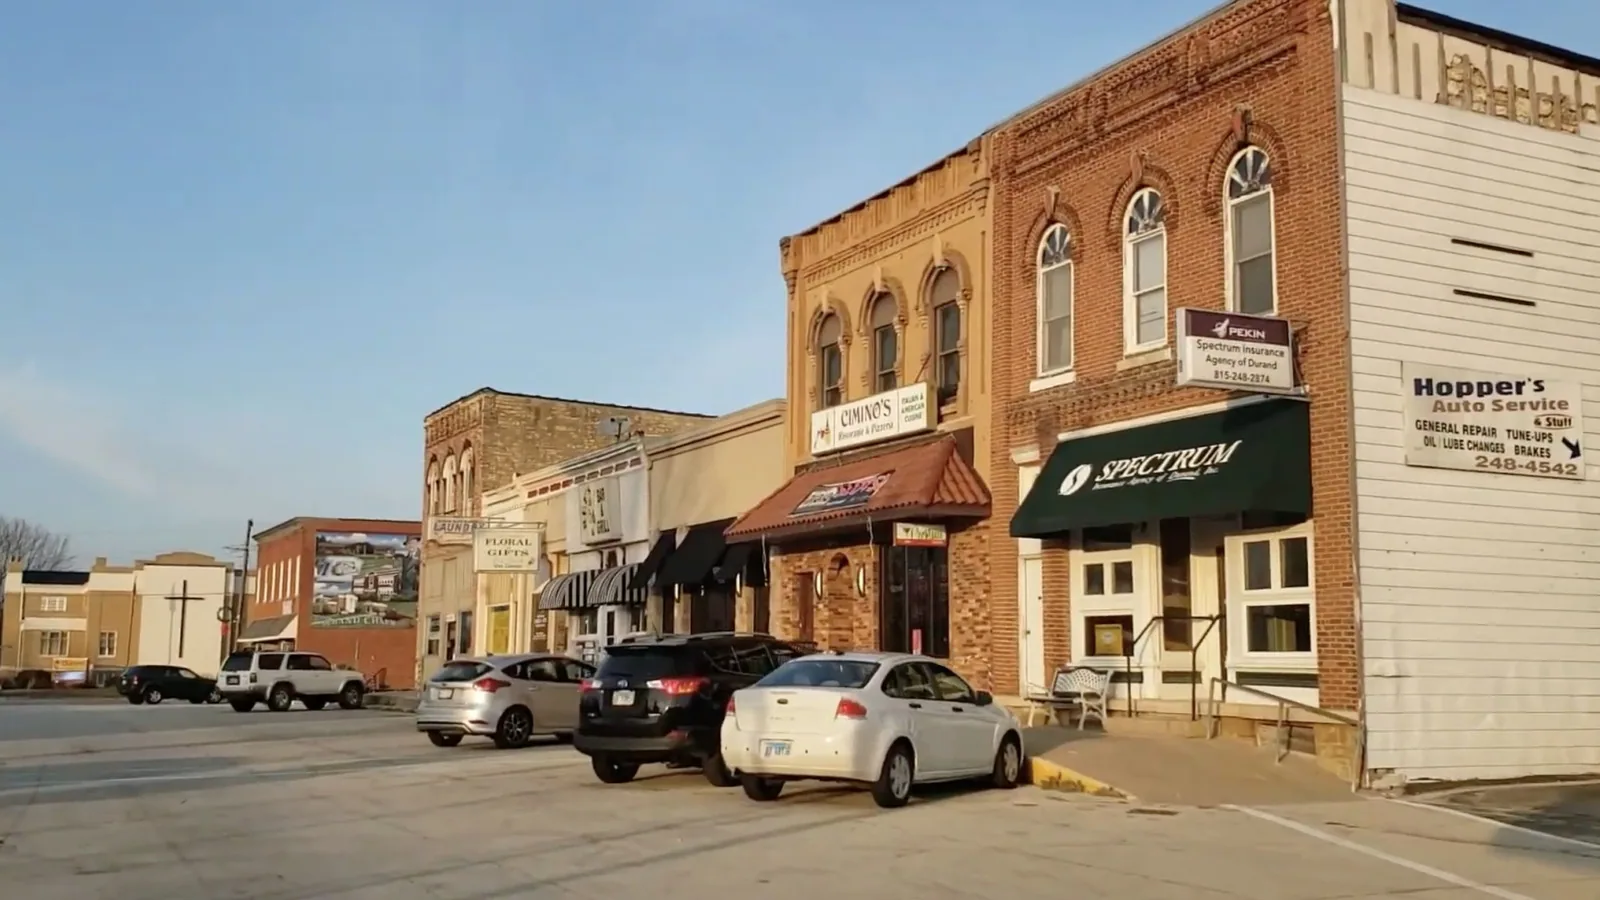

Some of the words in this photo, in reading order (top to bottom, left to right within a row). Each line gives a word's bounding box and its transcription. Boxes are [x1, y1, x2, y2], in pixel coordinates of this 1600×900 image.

[1229, 327, 1266, 340] PEKIN
[1196, 339, 1240, 352] Spectrum
[1242, 344, 1285, 358] Insurance
[1205, 354, 1237, 367] Agency
[1238, 356, 1247, 366] of
[1248, 357, 1278, 370] Durand
[1413, 377, 1546, 398] Hopper's
[840, 398, 892, 427] CIMINO'S
[1432, 399, 1485, 413] Auto
[1491, 397, 1570, 412] Service
[1415, 419, 1459, 435] GENERAL
[1462, 423, 1498, 438] REPAIR
[1506, 429, 1553, 443] TUNE-UPS
[1545, 415, 1572, 427] Stuff
[1423, 435, 1437, 448] OIL
[1443, 438, 1465, 451] LUBE
[1467, 440, 1505, 454] CHANGES
[1514, 445, 1551, 459] BRAKES
[1094, 439, 1243, 482] SPECTRUM
[1474, 455, 1578, 476] 248-4542
[485, 538, 532, 546] FLORAL
